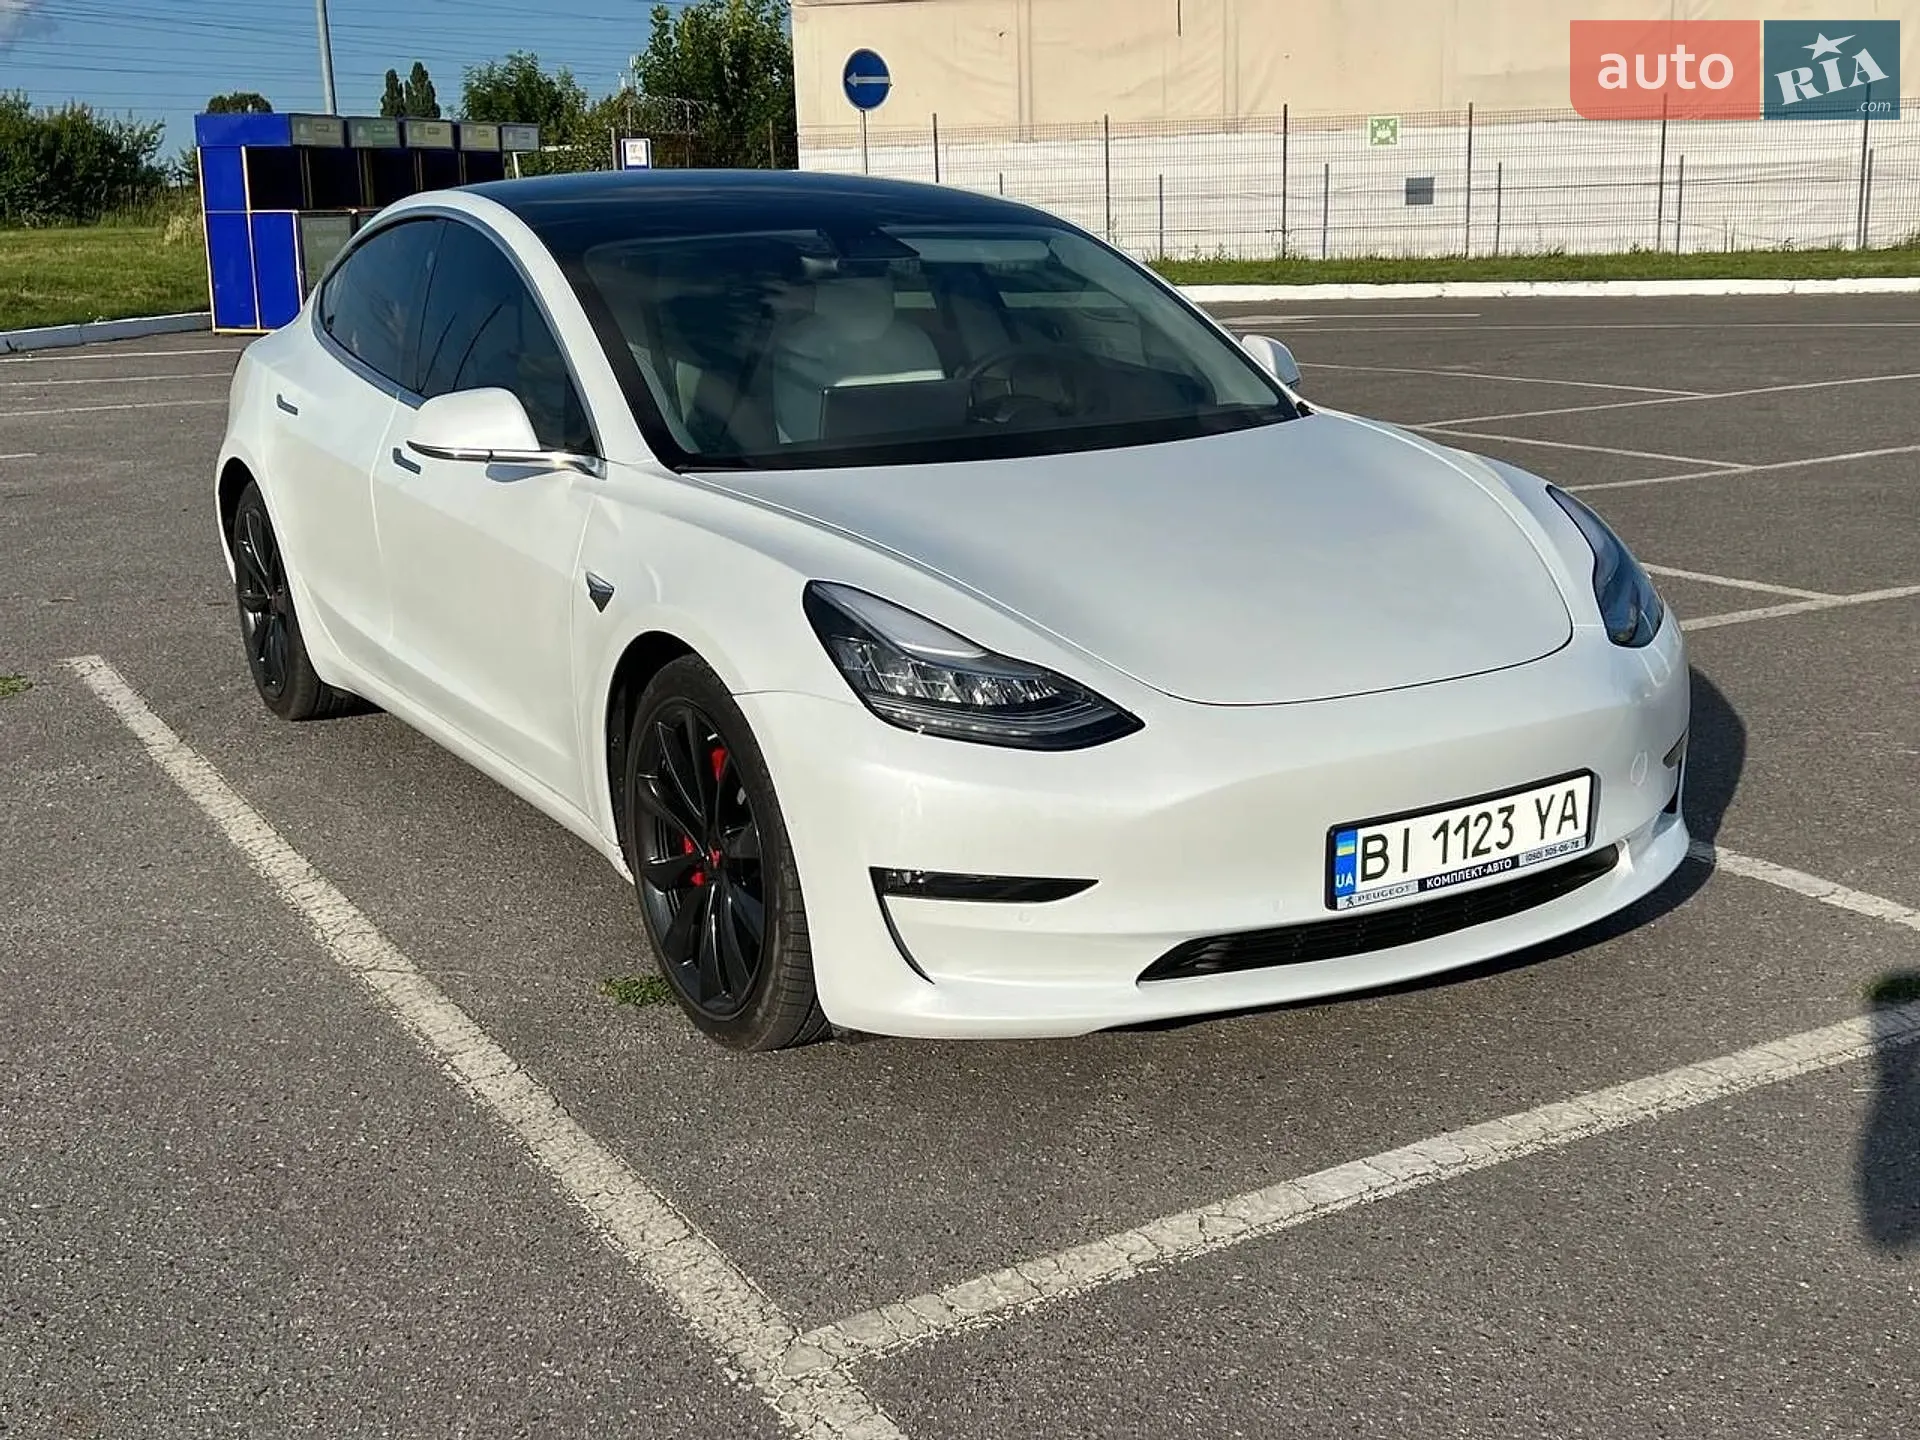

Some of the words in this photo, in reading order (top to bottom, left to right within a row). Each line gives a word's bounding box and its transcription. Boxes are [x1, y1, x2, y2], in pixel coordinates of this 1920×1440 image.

[1361, 828, 1410, 882] BI
[1432, 804, 1515, 865] 1123
[1535, 789, 1578, 840] YA
[1336, 872, 1354, 887] UA
[1357, 885, 1409, 901] PEUGEOT
